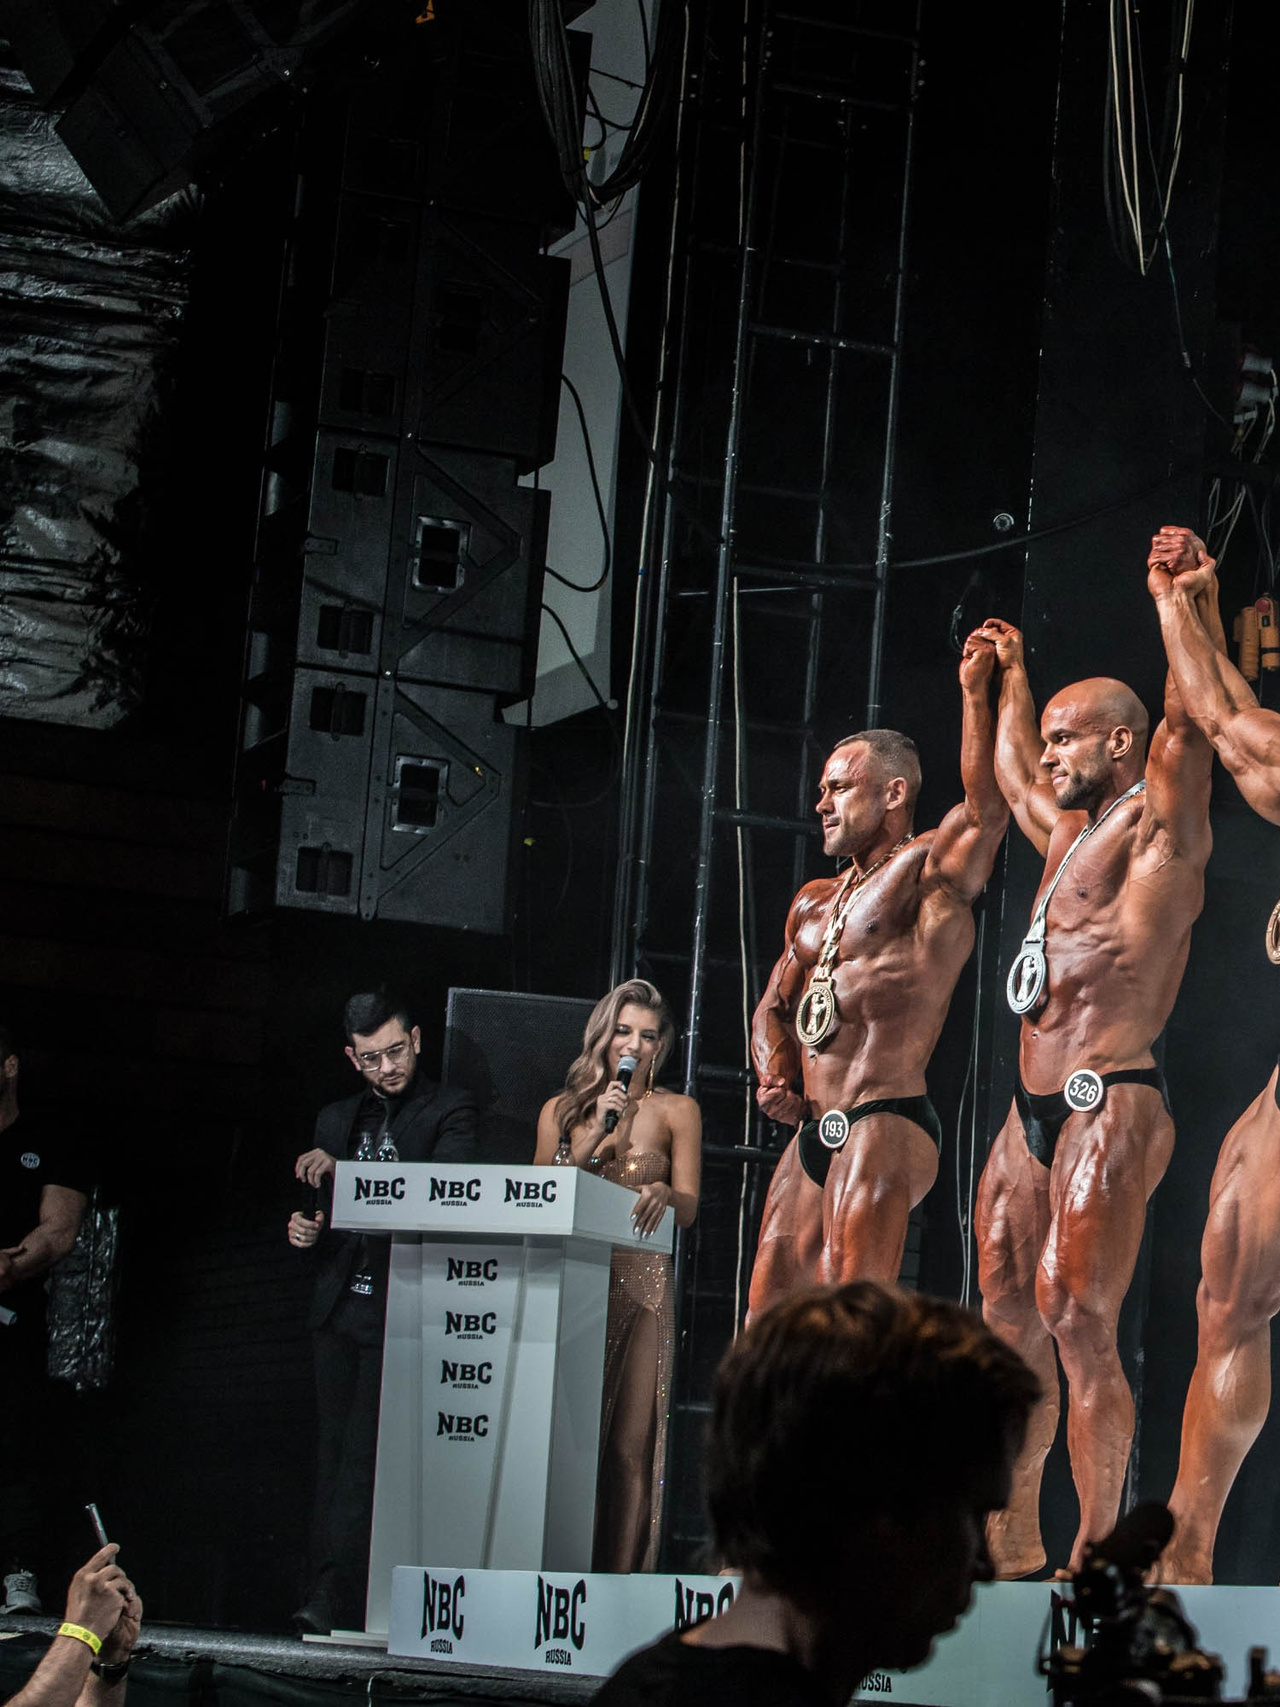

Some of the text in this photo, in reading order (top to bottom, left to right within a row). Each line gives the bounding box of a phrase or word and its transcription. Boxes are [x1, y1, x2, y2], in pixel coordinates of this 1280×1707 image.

[1069, 1078, 1098, 1103] 326
[824, 1120, 843, 1139] 193
[354, 1176, 406, 1201] NBC
[428, 1177, 482, 1202] NBC
[503, 1178, 557, 1203] NBC
[446, 1257, 499, 1282] NBC
[444, 1310, 497, 1335] NBC
[440, 1358, 493, 1385] NBC
[436, 1410, 490, 1438] NBC
[421, 1570, 465, 1641] NBC
[534, 1574, 587, 1651] NBC
[430, 1639, 454, 1655] RUSSIA
[545, 1650, 572, 1667] RUSSIA
[857, 1672, 893, 1693] USSIA
